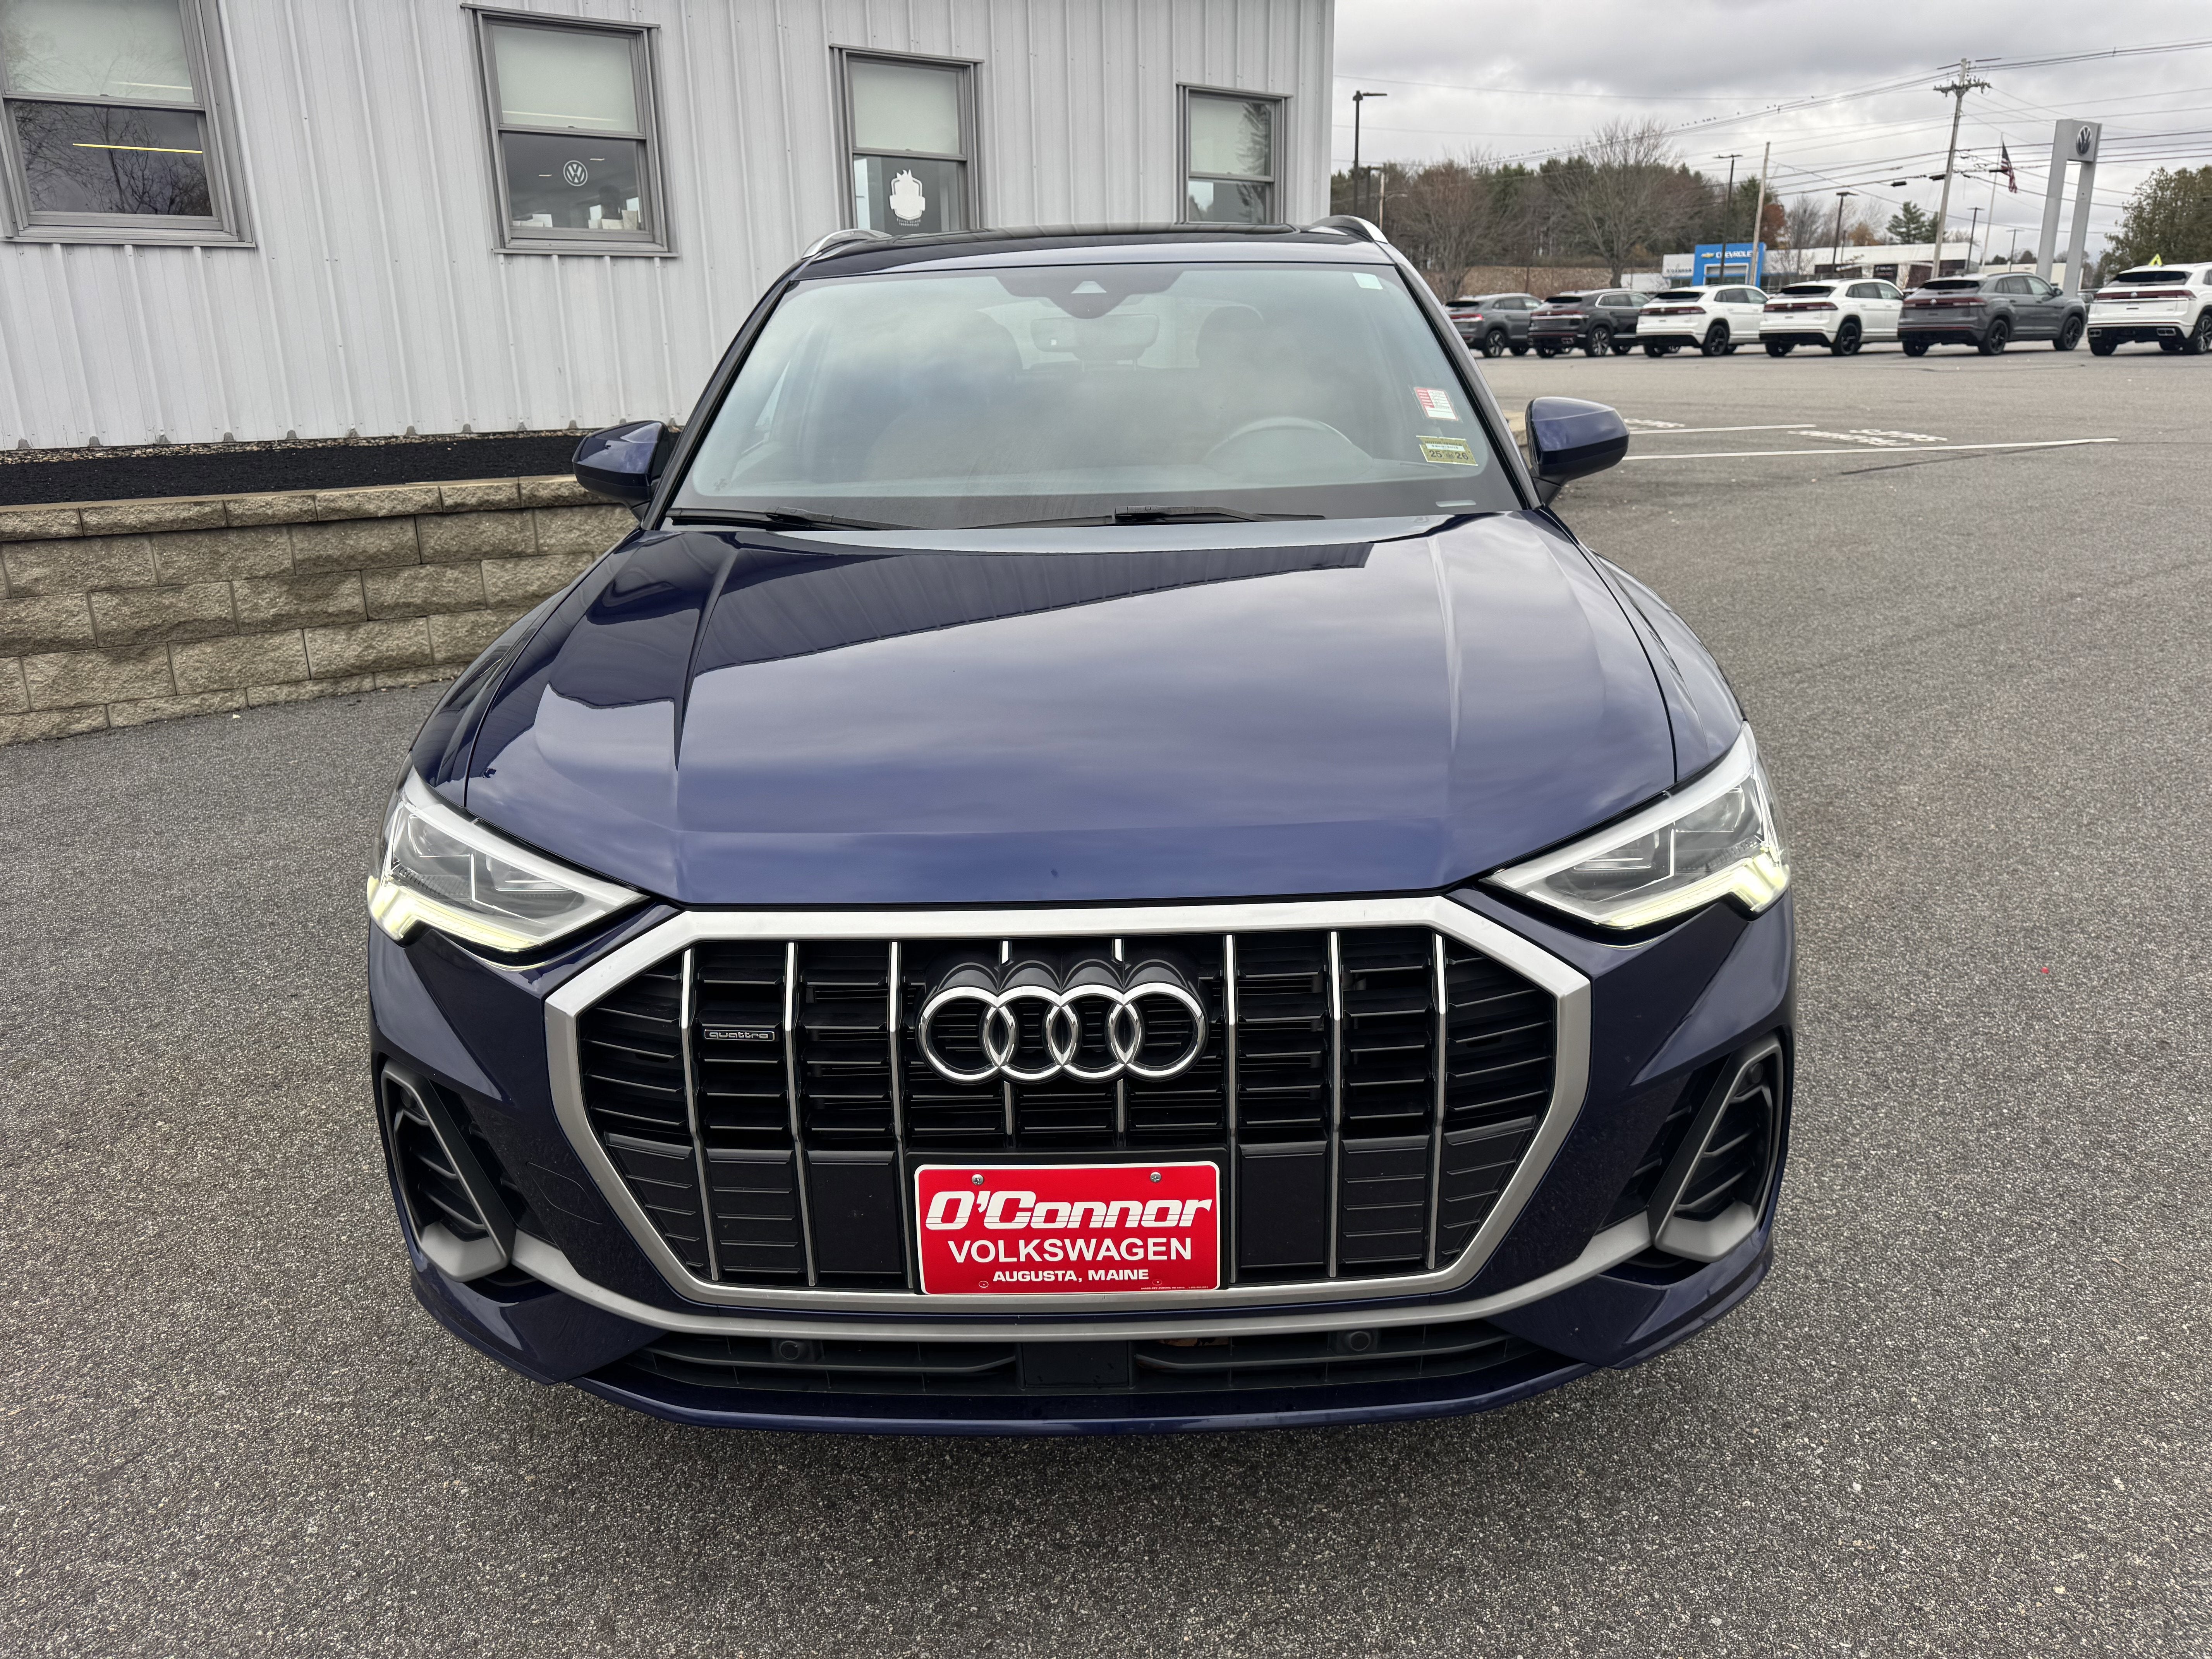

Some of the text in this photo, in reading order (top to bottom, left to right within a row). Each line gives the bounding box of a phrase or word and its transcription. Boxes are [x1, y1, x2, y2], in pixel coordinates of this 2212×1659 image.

[926, 1191, 1212, 1230] O'Connor
[948, 1237, 1191, 1263] VOLKSWAGEN
[993, 1269, 1149, 1283] AUGUSTA, MAINE
